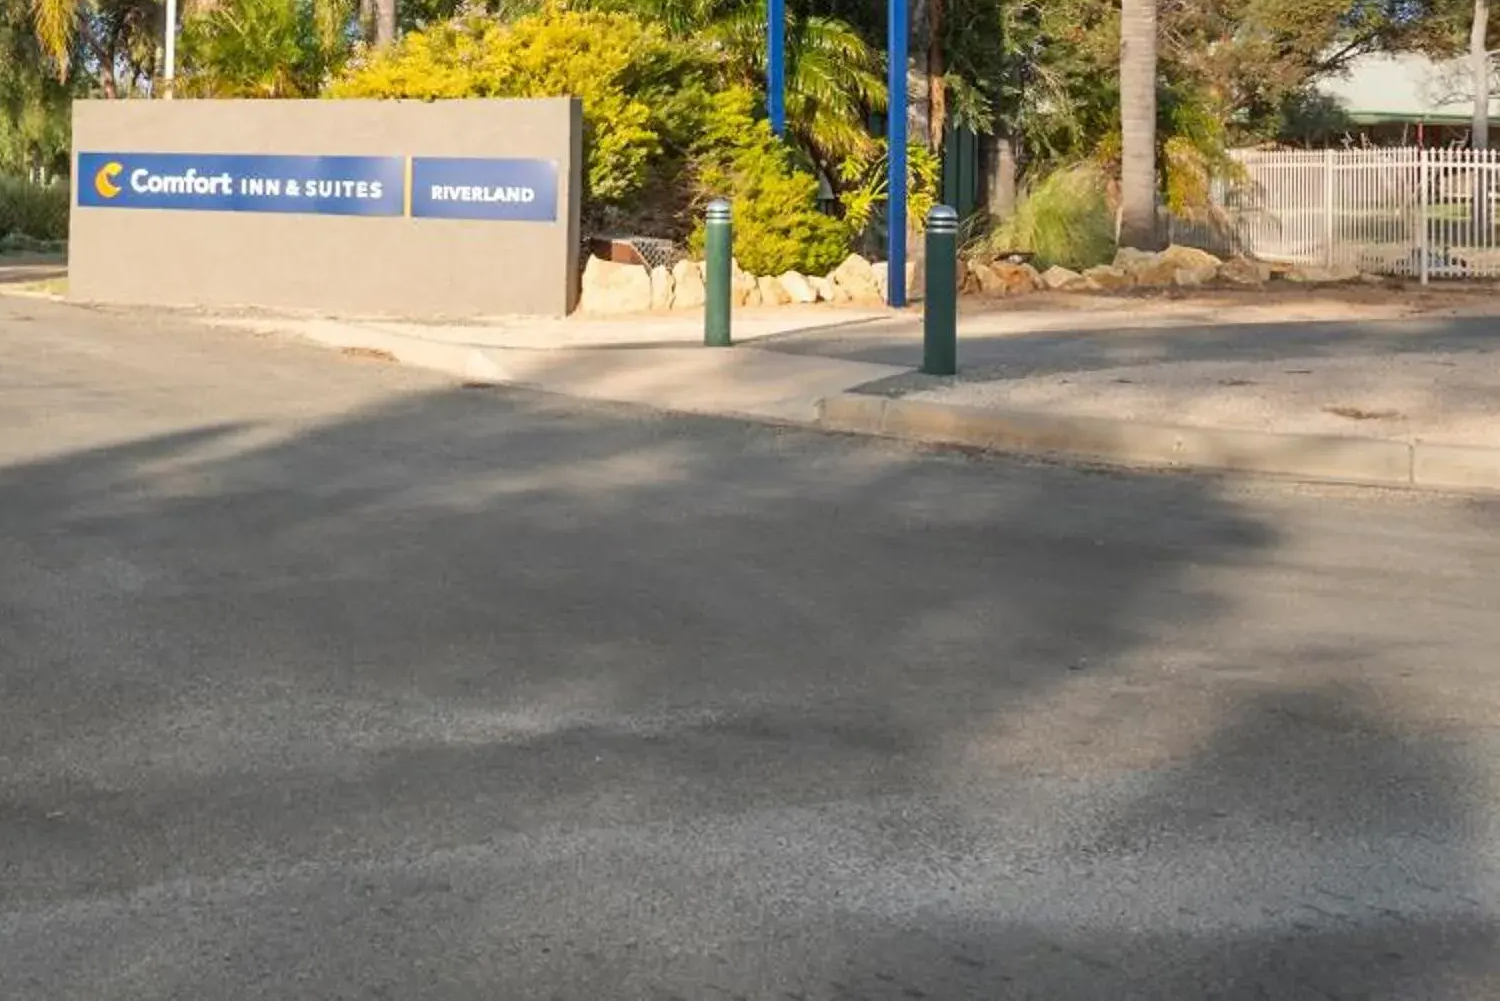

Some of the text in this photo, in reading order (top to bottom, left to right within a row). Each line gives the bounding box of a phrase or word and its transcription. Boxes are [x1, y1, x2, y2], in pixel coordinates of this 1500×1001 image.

[130, 168, 383, 199] Comfort INN & SUITES
[431, 185, 535, 203] RIVERLAND
